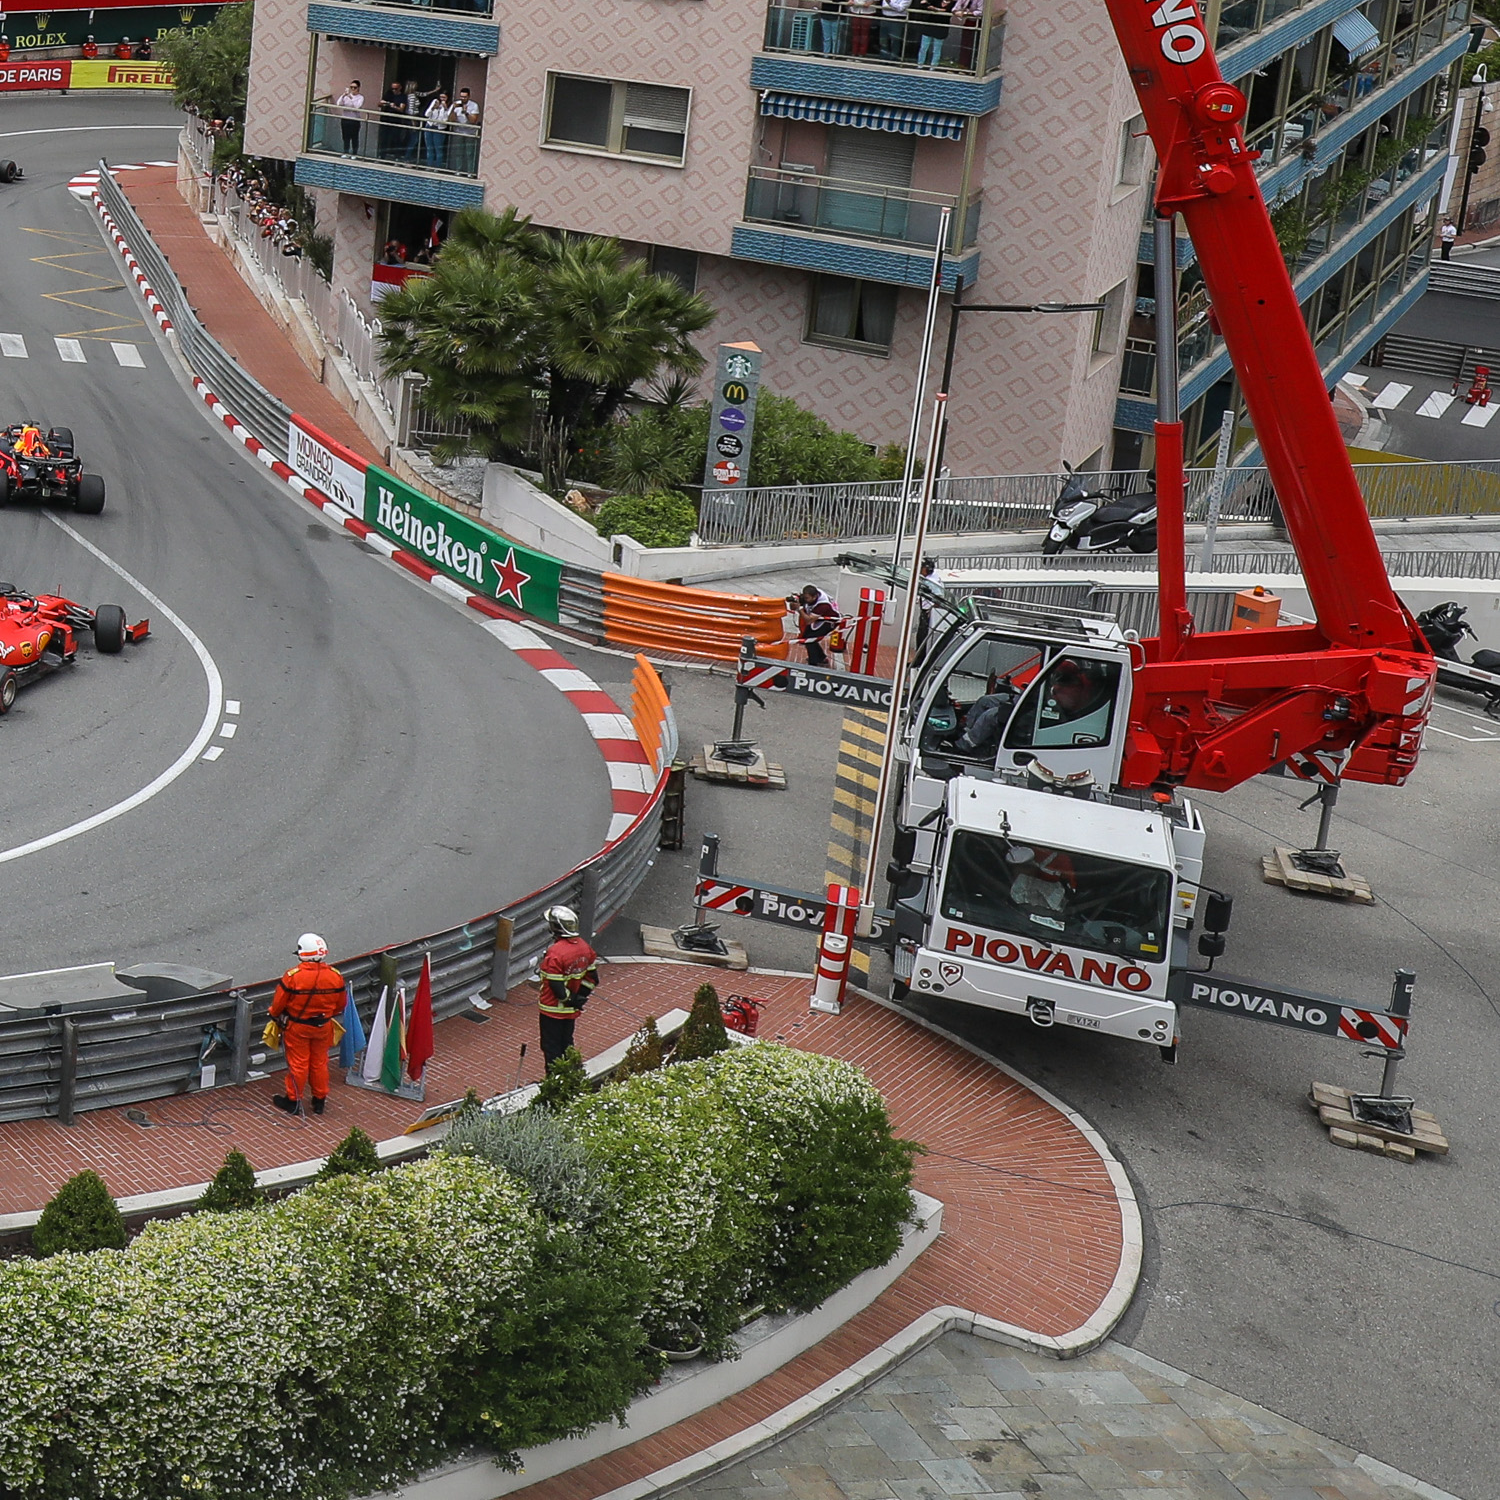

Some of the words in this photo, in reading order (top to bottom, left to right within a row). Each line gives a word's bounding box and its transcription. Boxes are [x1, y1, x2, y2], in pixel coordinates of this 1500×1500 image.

[14, 32, 67, 48] ROLEX
[18, 67, 62, 84] PARIS
[296, 431, 334, 477] MONACO
[376, 485, 484, 585] Heineken
[945, 926, 1153, 994] PIOVANO
[1191, 982, 1329, 1027] PIOVANO
